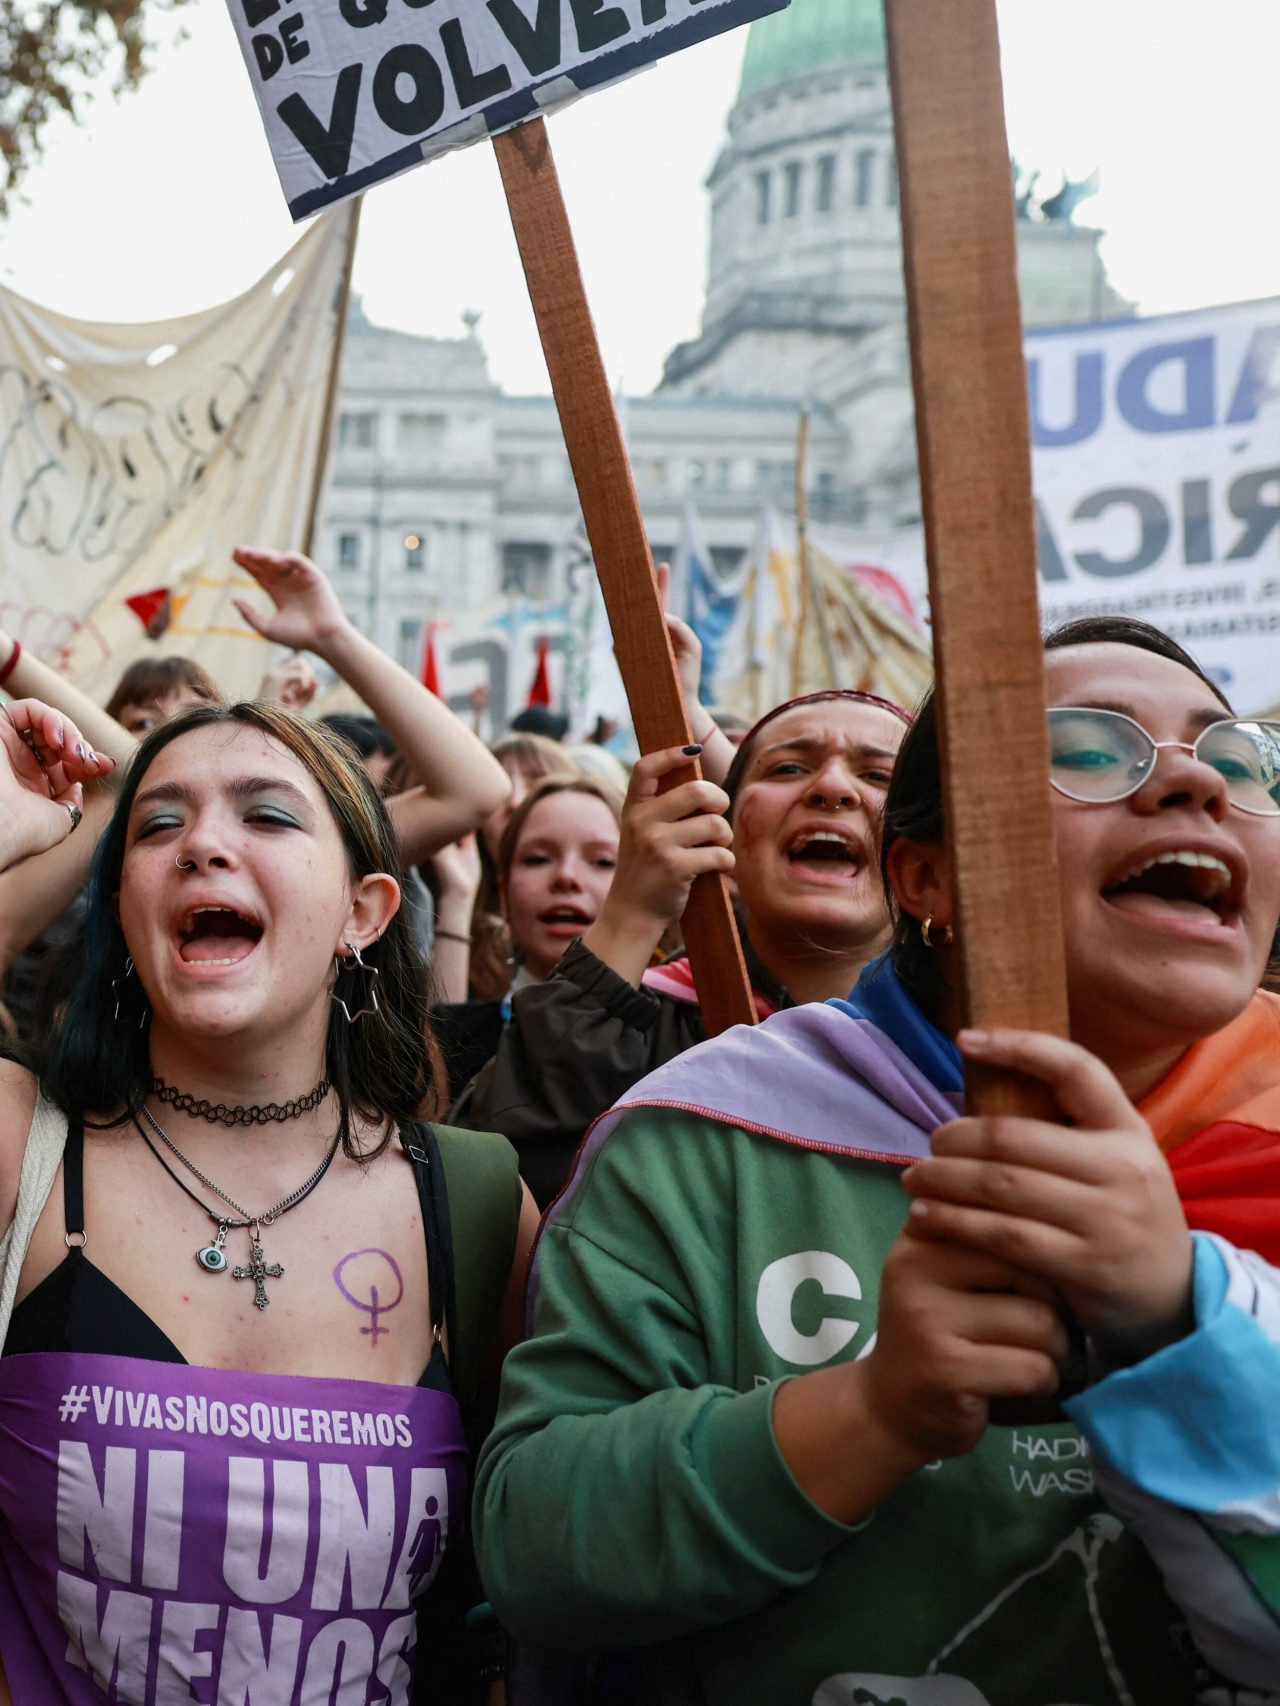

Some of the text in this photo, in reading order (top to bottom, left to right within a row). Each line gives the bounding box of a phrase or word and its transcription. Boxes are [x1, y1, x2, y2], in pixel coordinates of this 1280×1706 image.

[251, 12, 310, 82] DE
[277, 0, 716, 179] VOLVE
[58, 1385, 413, 1448] #VIVASNOSQUEREMOS
[56, 1440, 449, 1611] NI UNA
[56, 1570, 419, 1706] MENOS
